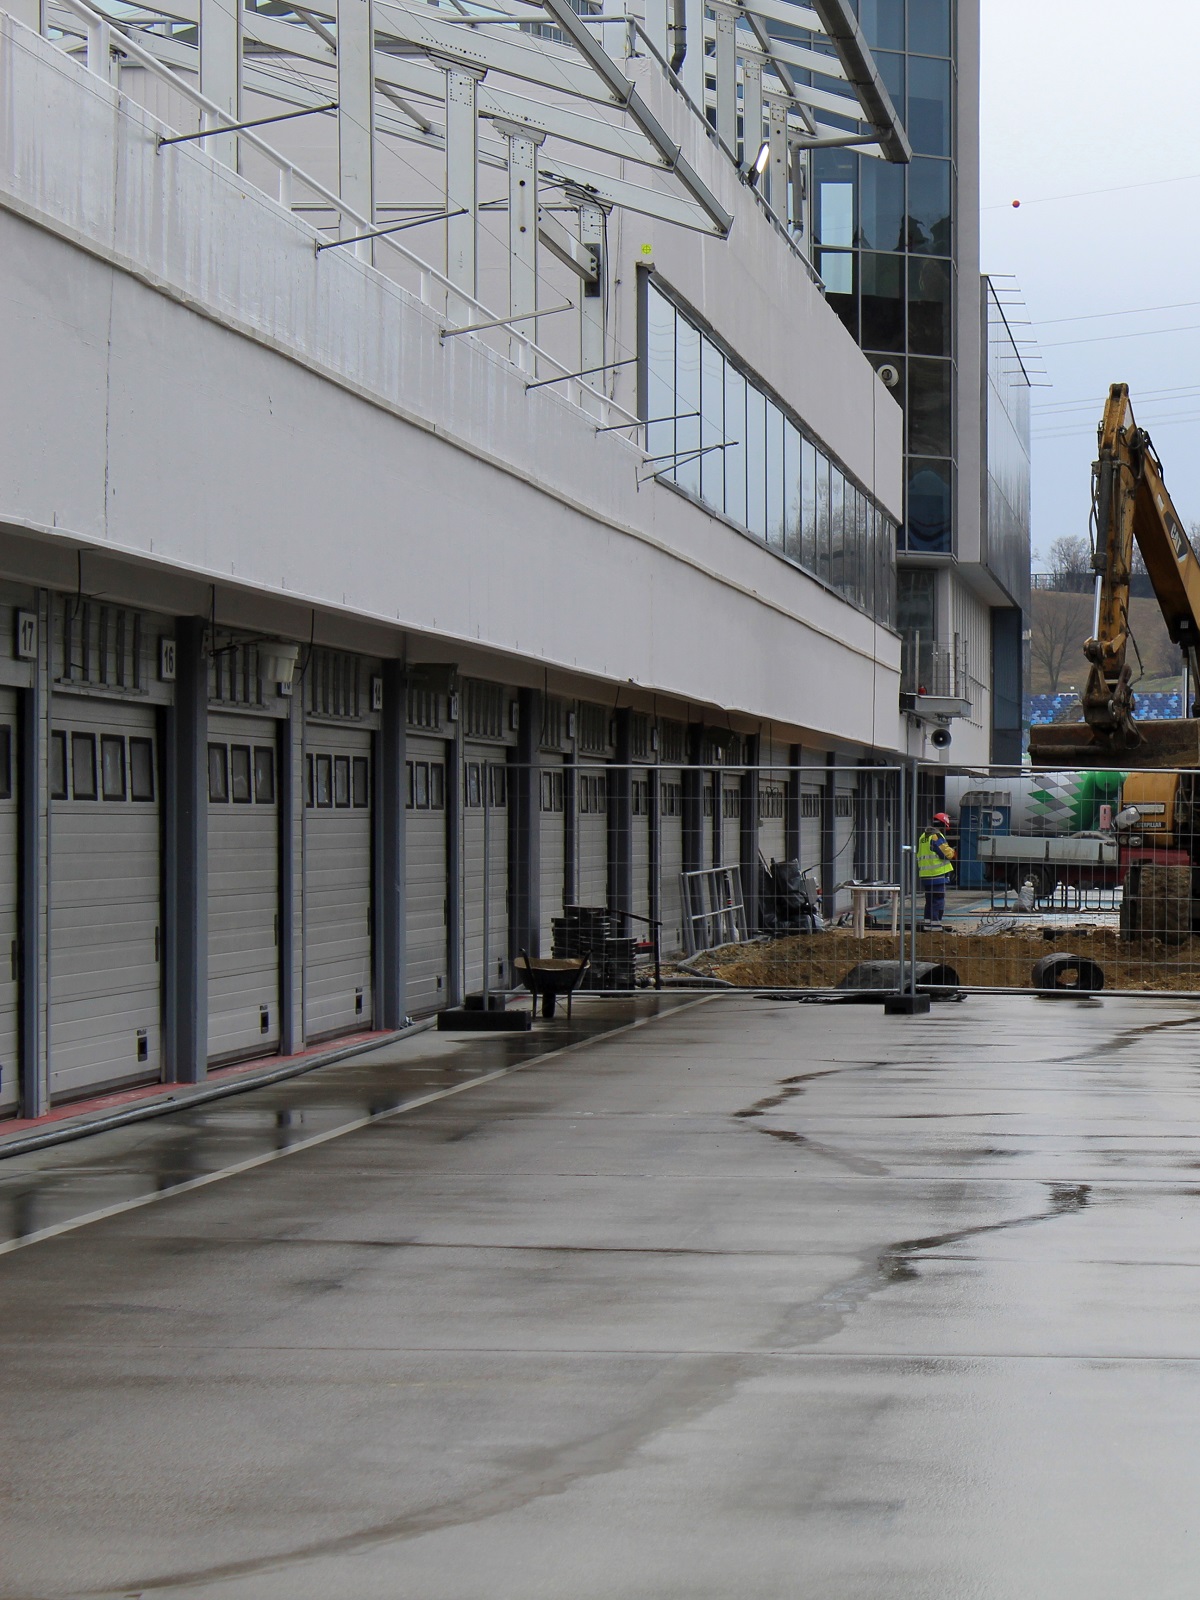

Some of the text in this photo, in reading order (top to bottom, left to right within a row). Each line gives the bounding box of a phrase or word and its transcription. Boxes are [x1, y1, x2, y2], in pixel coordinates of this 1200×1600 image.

[1170, 522, 1182, 554] CAT
[22, 620, 34, 651] 17
[164, 645, 174, 673] 16
